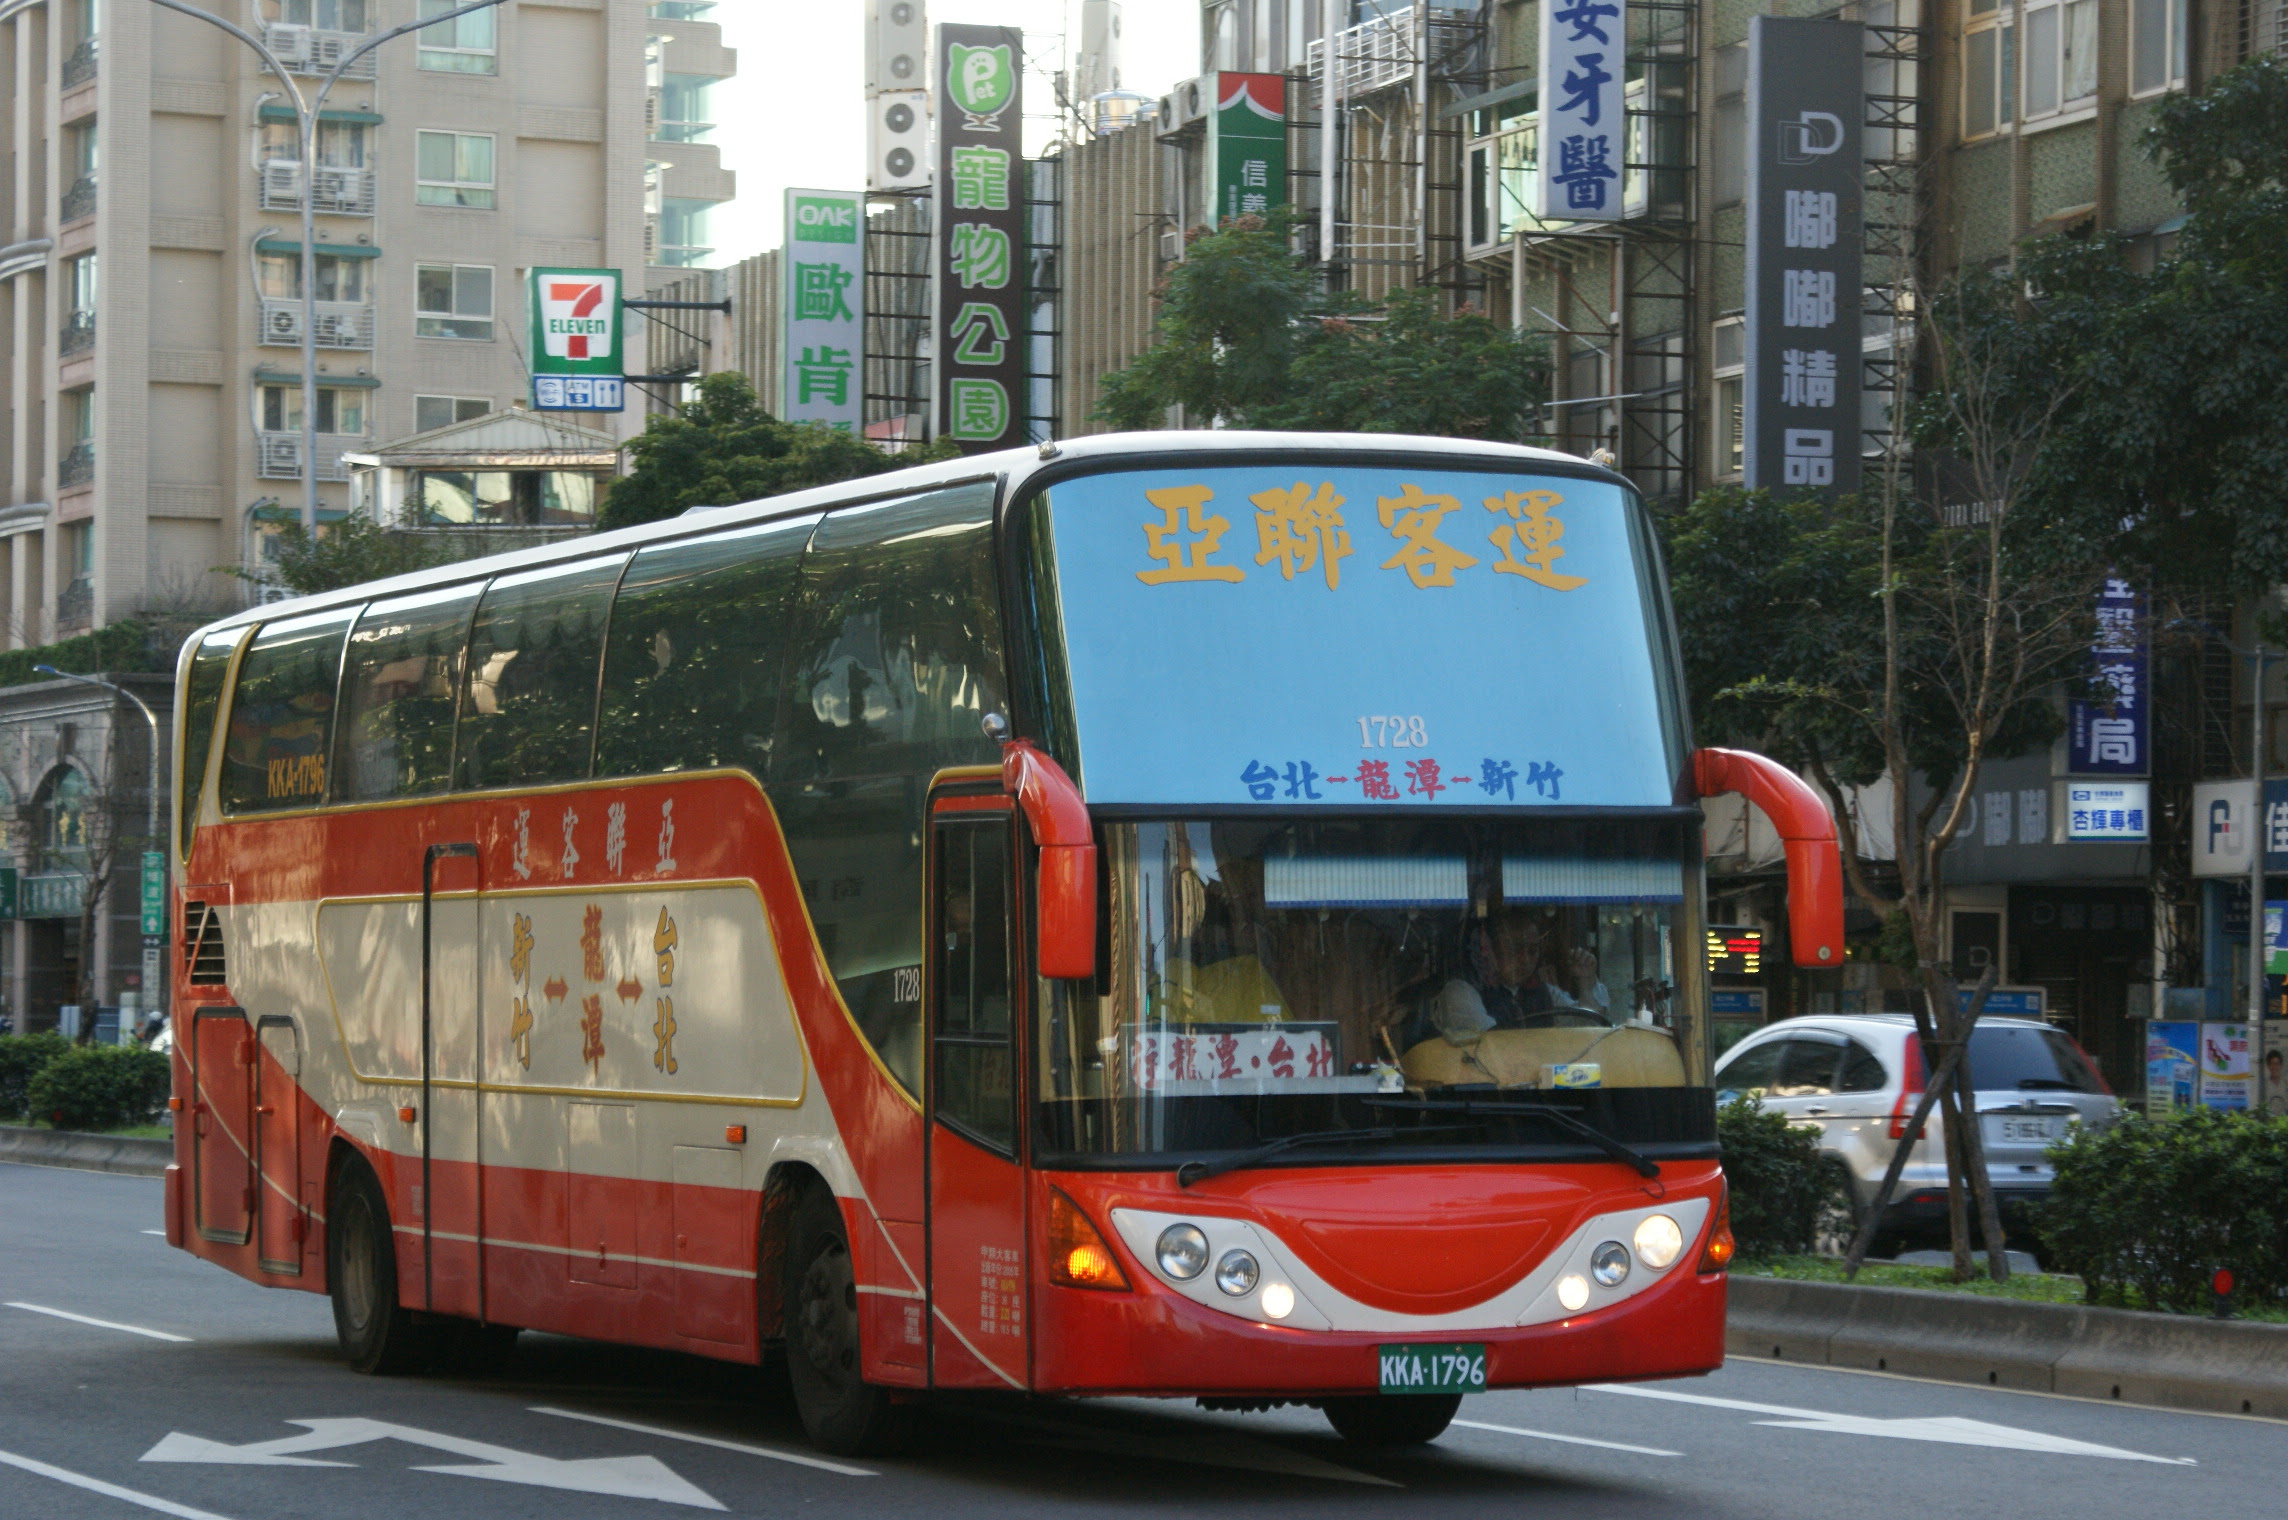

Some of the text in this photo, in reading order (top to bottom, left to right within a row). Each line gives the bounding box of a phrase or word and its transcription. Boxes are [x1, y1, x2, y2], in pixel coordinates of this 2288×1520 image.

[963, 51, 998, 105] Pet
[799, 205, 853, 227] OAK
[794, 261, 854, 406] 歐肯
[950, 145, 1011, 441] 寵物公園
[1781, 189, 1837, 486] 嘟嘟精品
[1136, 482, 1590, 591] 亞聯客運
[1240, 757, 1564, 801] 台北 龍潭 新竹
[1357, 716, 1428, 748] 1728
[510, 912, 534, 1072] 新竹
[580, 904, 604, 1076] 龍潭
[653, 905, 678, 1075] 台北
[894, 968, 920, 1002] 1728
